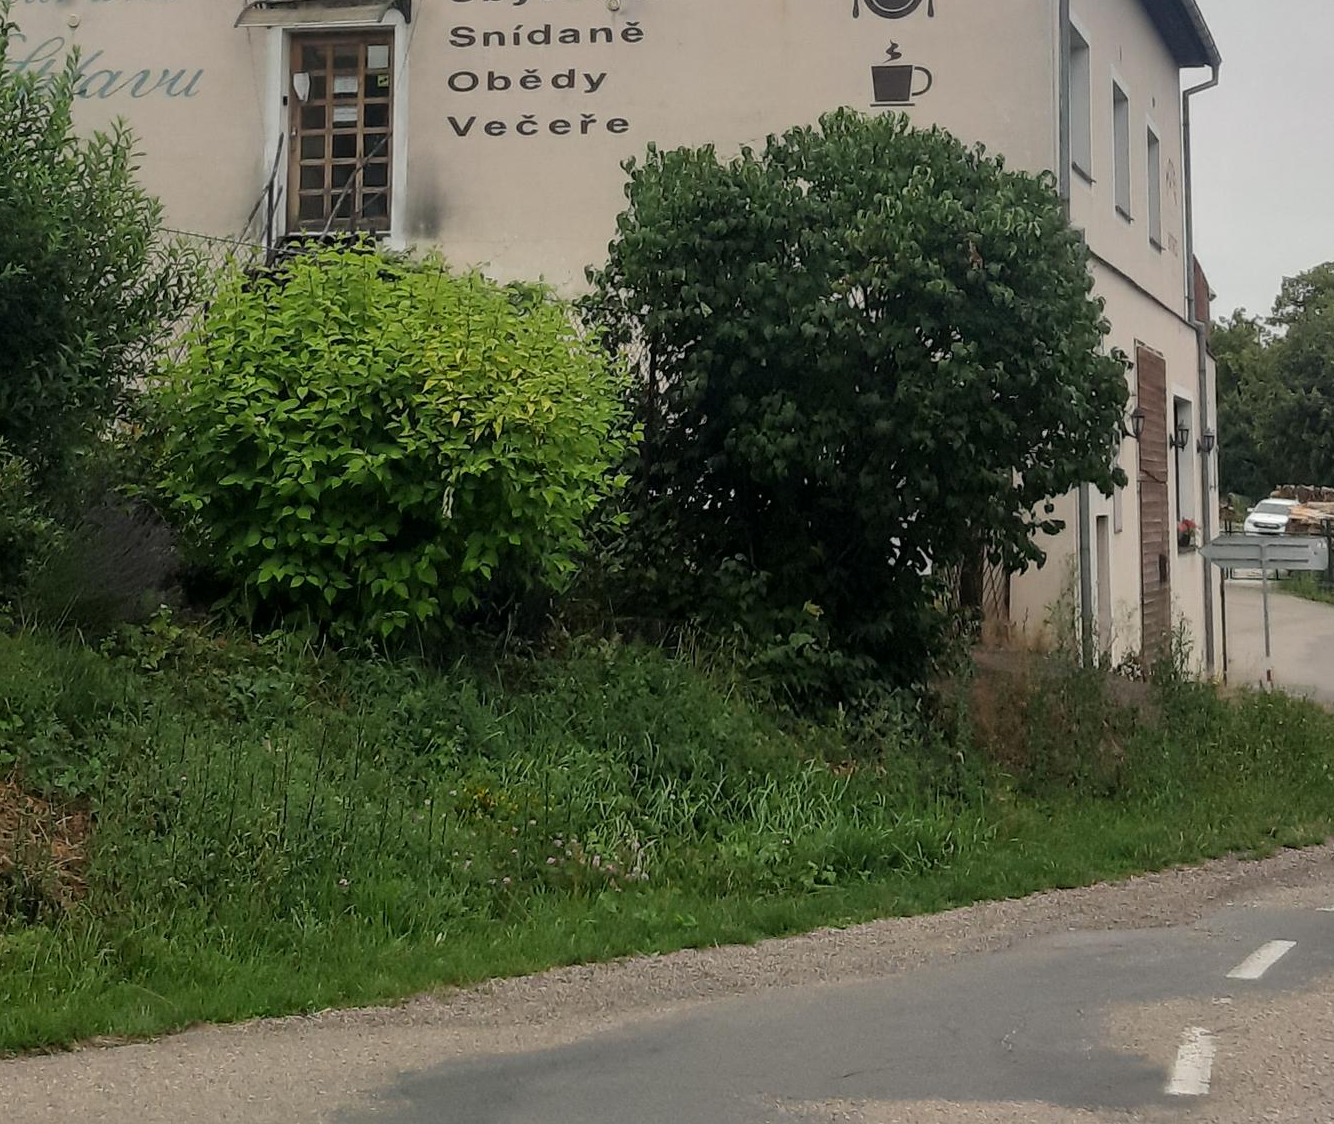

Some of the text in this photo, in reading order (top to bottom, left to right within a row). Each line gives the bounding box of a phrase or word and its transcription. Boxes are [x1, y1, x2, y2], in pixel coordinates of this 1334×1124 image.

[448, 21, 645, 47] Snídaně
[447, 68, 608, 93] Obědy
[447, 113, 630, 137] Večeře
